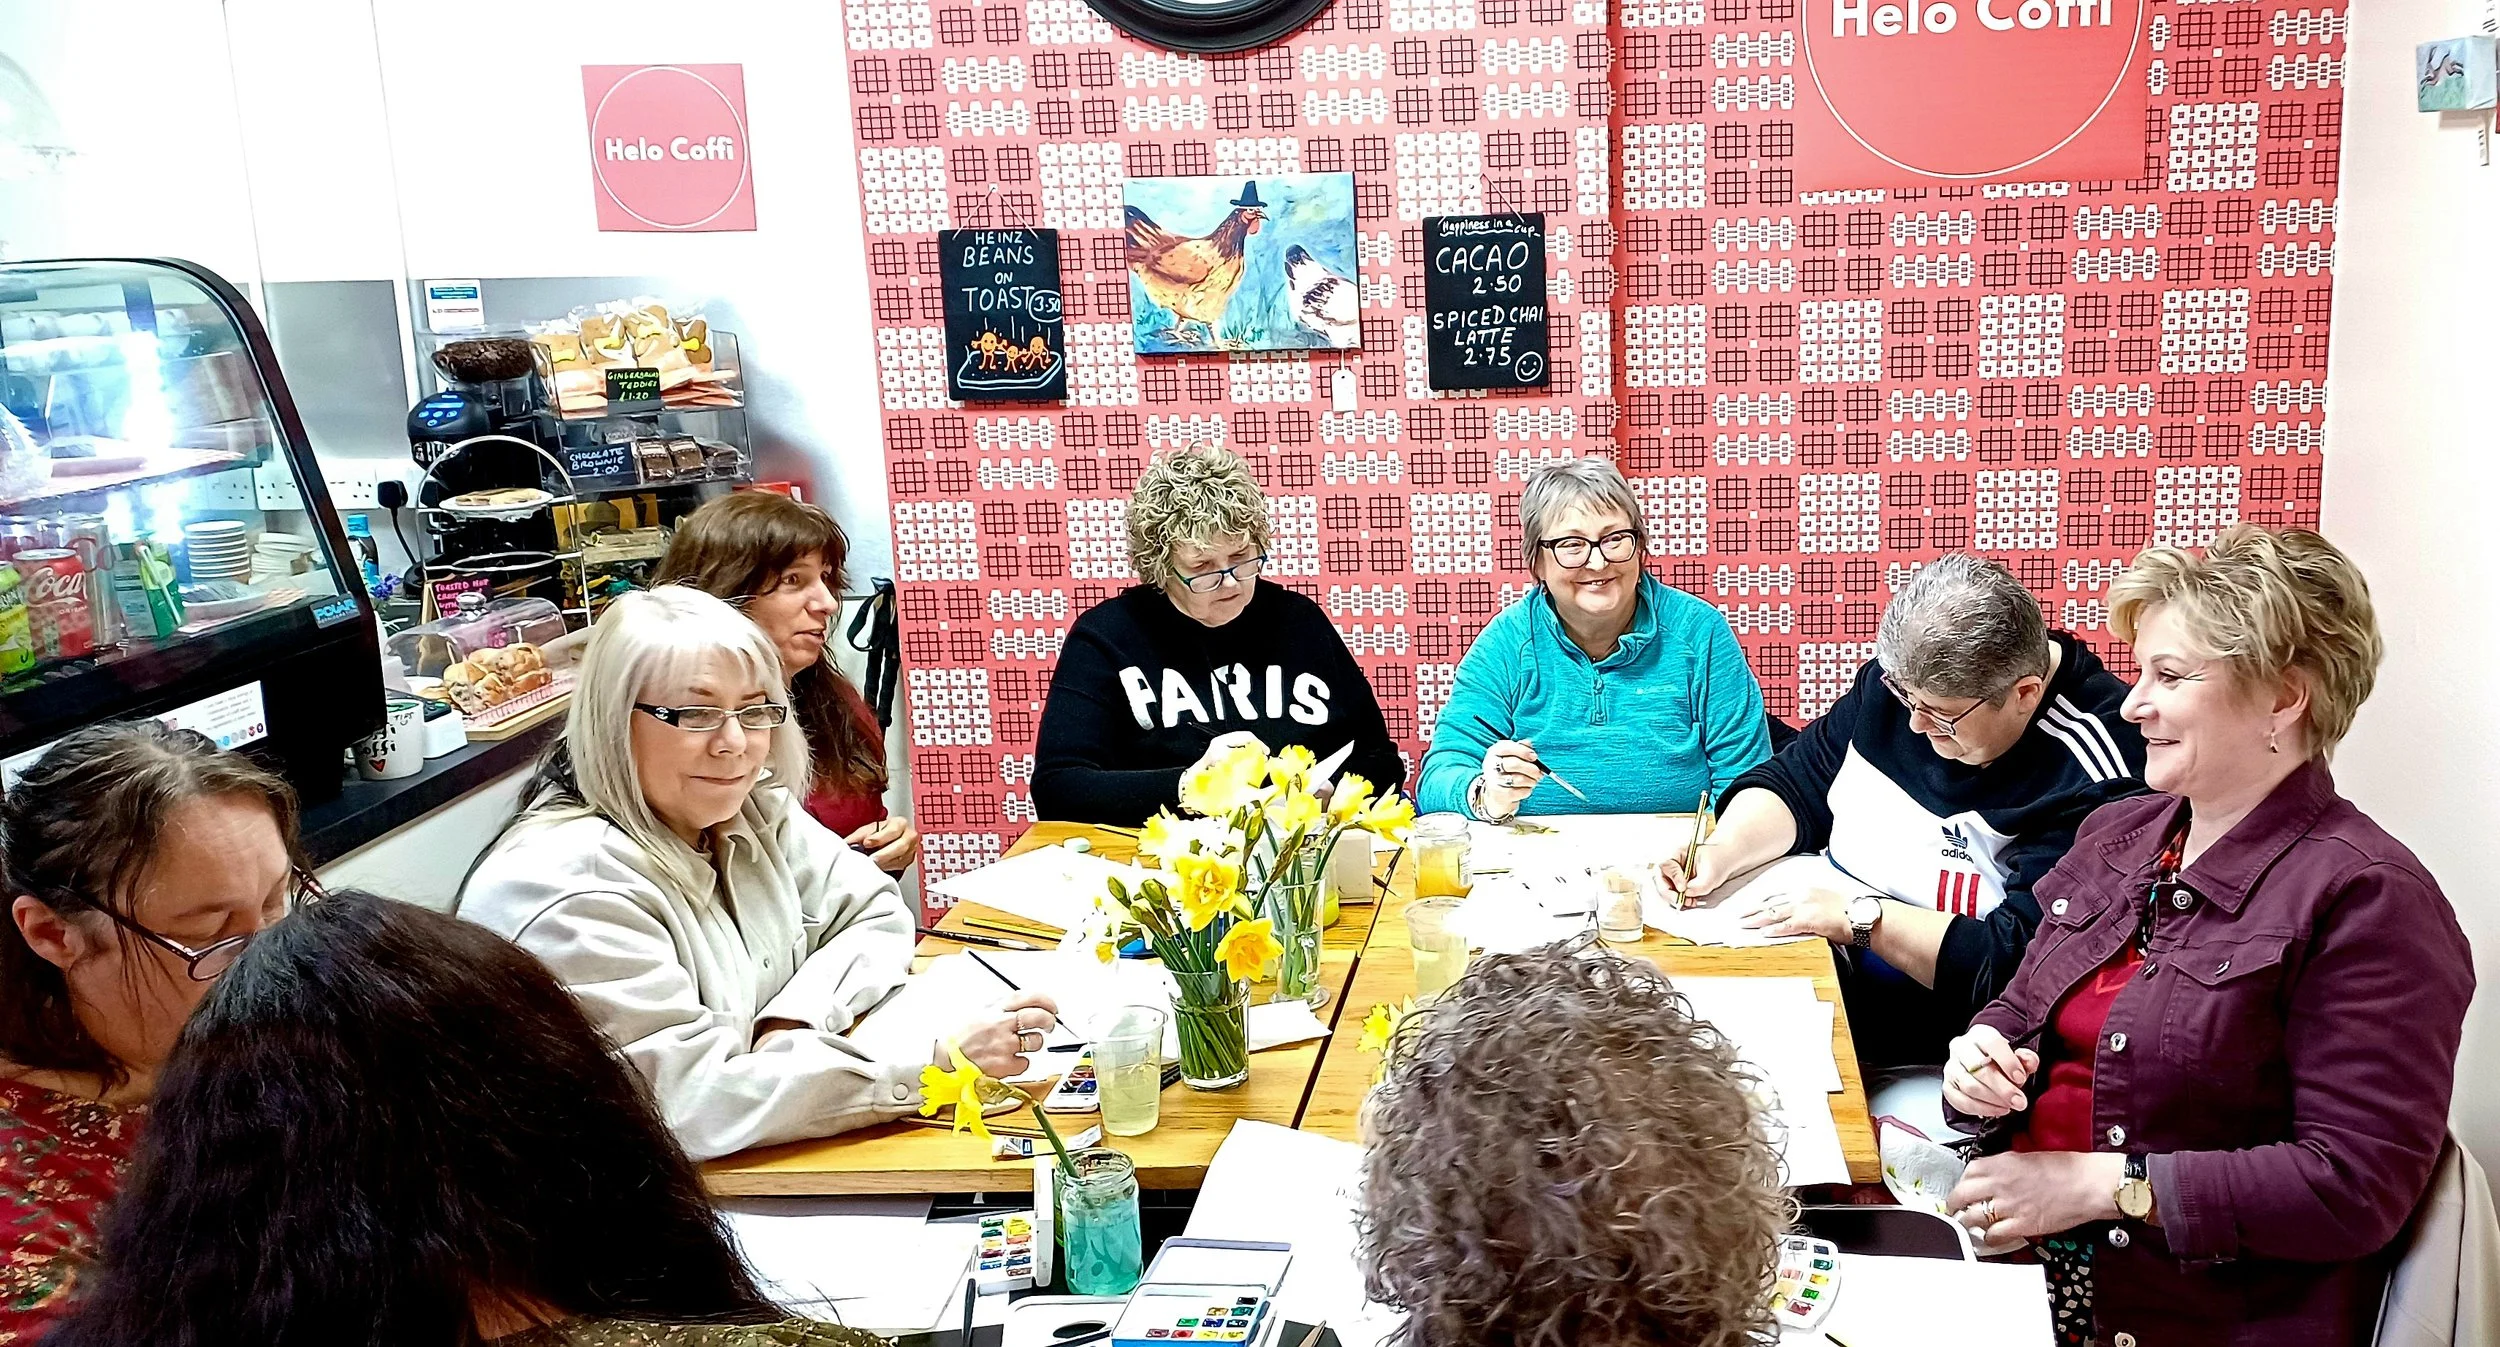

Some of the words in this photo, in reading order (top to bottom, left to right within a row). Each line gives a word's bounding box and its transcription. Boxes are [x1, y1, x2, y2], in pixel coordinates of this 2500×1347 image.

[1832, 0, 1957, 38] Helo
[604, 136, 664, 161] Helo
[669, 135, 734, 161] Coffi
[975, 231, 1023, 245] HEINZ
[1442, 218, 1490, 237] Happiness
[1493, 218, 1503, 228] in
[1505, 219, 1513, 227] a
[1514, 224, 1535, 238] cup
[962, 245, 1034, 268] BEANS
[1436, 241, 1529, 274] CACAO
[994, 271, 1013, 284] ON
[1472, 274, 1522, 294] 2.50
[961, 286, 1035, 312] TOAST
[1033, 296, 1061, 313] 3.50
[1433, 305, 1505, 330] SPICED
[1509, 305, 1544, 323] CHAI
[1454, 326, 1516, 346] LATTE
[1463, 346, 1512, 366] 2.75
[619, 380, 657, 389] TEDDIES
[619, 391, 649, 402] £1.20
[569, 447, 625, 461] CHOCOLATE
[571, 455, 625, 470] BROWNIE
[592, 465, 619, 476] 2.00
[29, 567, 88, 600] Coca
[435, 581, 469, 592] TOASTED
[313, 598, 357, 620] POLAR
[1118, 662, 1331, 730] PARIS
[361, 739, 396, 757] offi
[1941, 847, 1974, 864] adida
